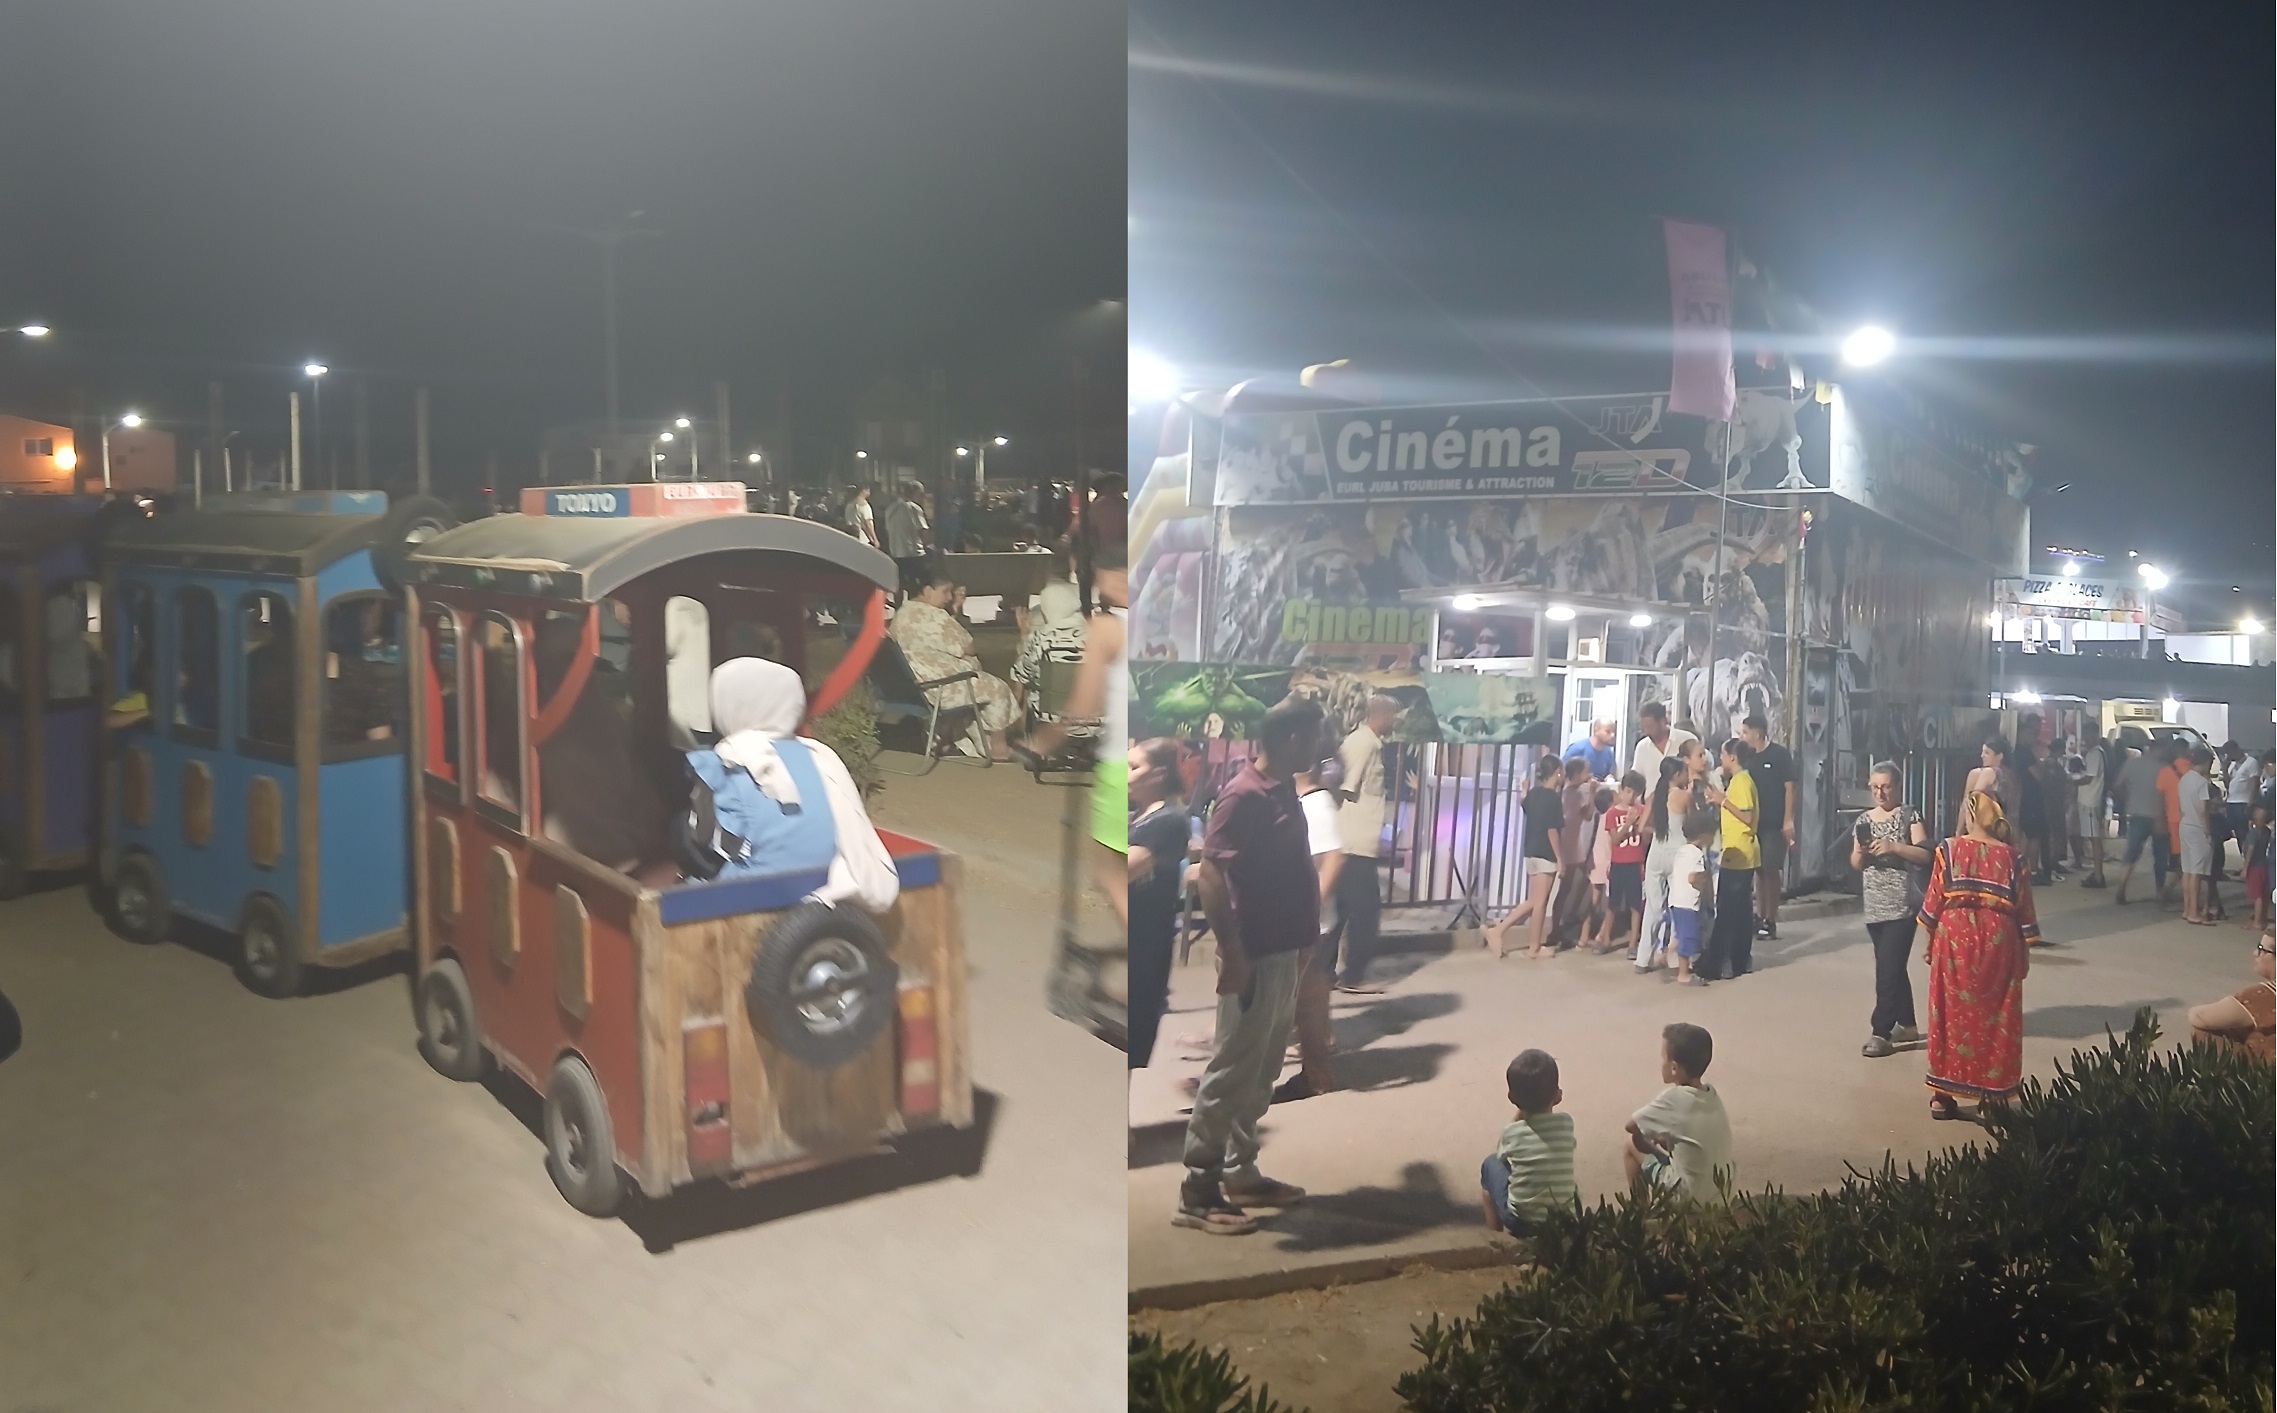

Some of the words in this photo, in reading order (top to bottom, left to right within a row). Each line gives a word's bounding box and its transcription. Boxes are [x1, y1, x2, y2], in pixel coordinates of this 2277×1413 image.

[1589, 400, 1662, 440] JTA
[1336, 415, 1560, 473] Cinéma
[1337, 482, 1366, 494] EURL
[1369, 480, 1399, 493] JUBA
[1403, 478, 1461, 492] TOURISME
[1466, 477, 1474, 490] &
[1478, 477, 1554, 490] ATTRACTION
[1572, 449, 1692, 490] 12D
[2023, 579, 2053, 594] PIZZA
[1283, 598, 1429, 643] Cinéma
